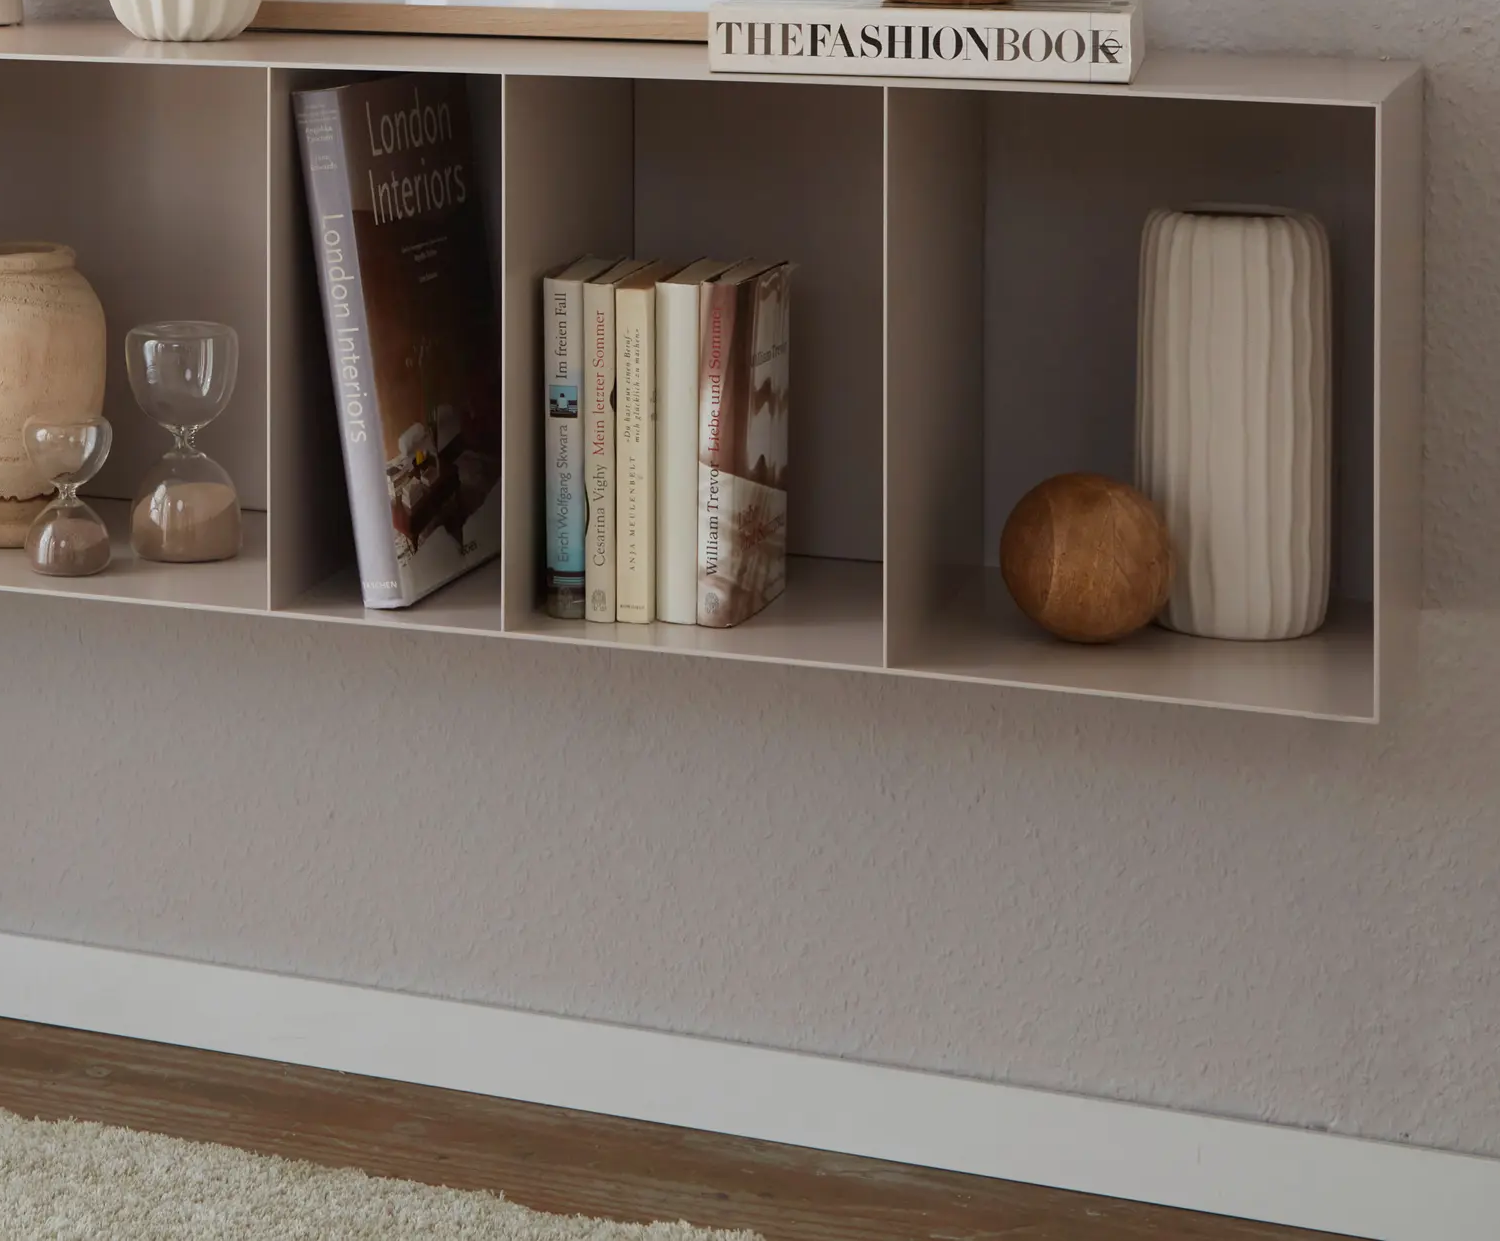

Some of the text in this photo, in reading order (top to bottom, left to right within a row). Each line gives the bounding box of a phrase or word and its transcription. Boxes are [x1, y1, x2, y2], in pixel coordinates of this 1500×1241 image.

[365, 86, 452, 157] London
[368, 163, 466, 226] Interiors
[323, 213, 367, 445] London Interiors
[554, 292, 568, 379] Im freien Fall
[592, 310, 605, 456] Mein letzter Sommer
[707, 306, 722, 453] Liebe und Sommer
[556, 424, 572, 563] Erich Wolfgang Skwara
[592, 464, 608, 567] Cesarina Vighy
[706, 460, 719, 577] William Trevor
